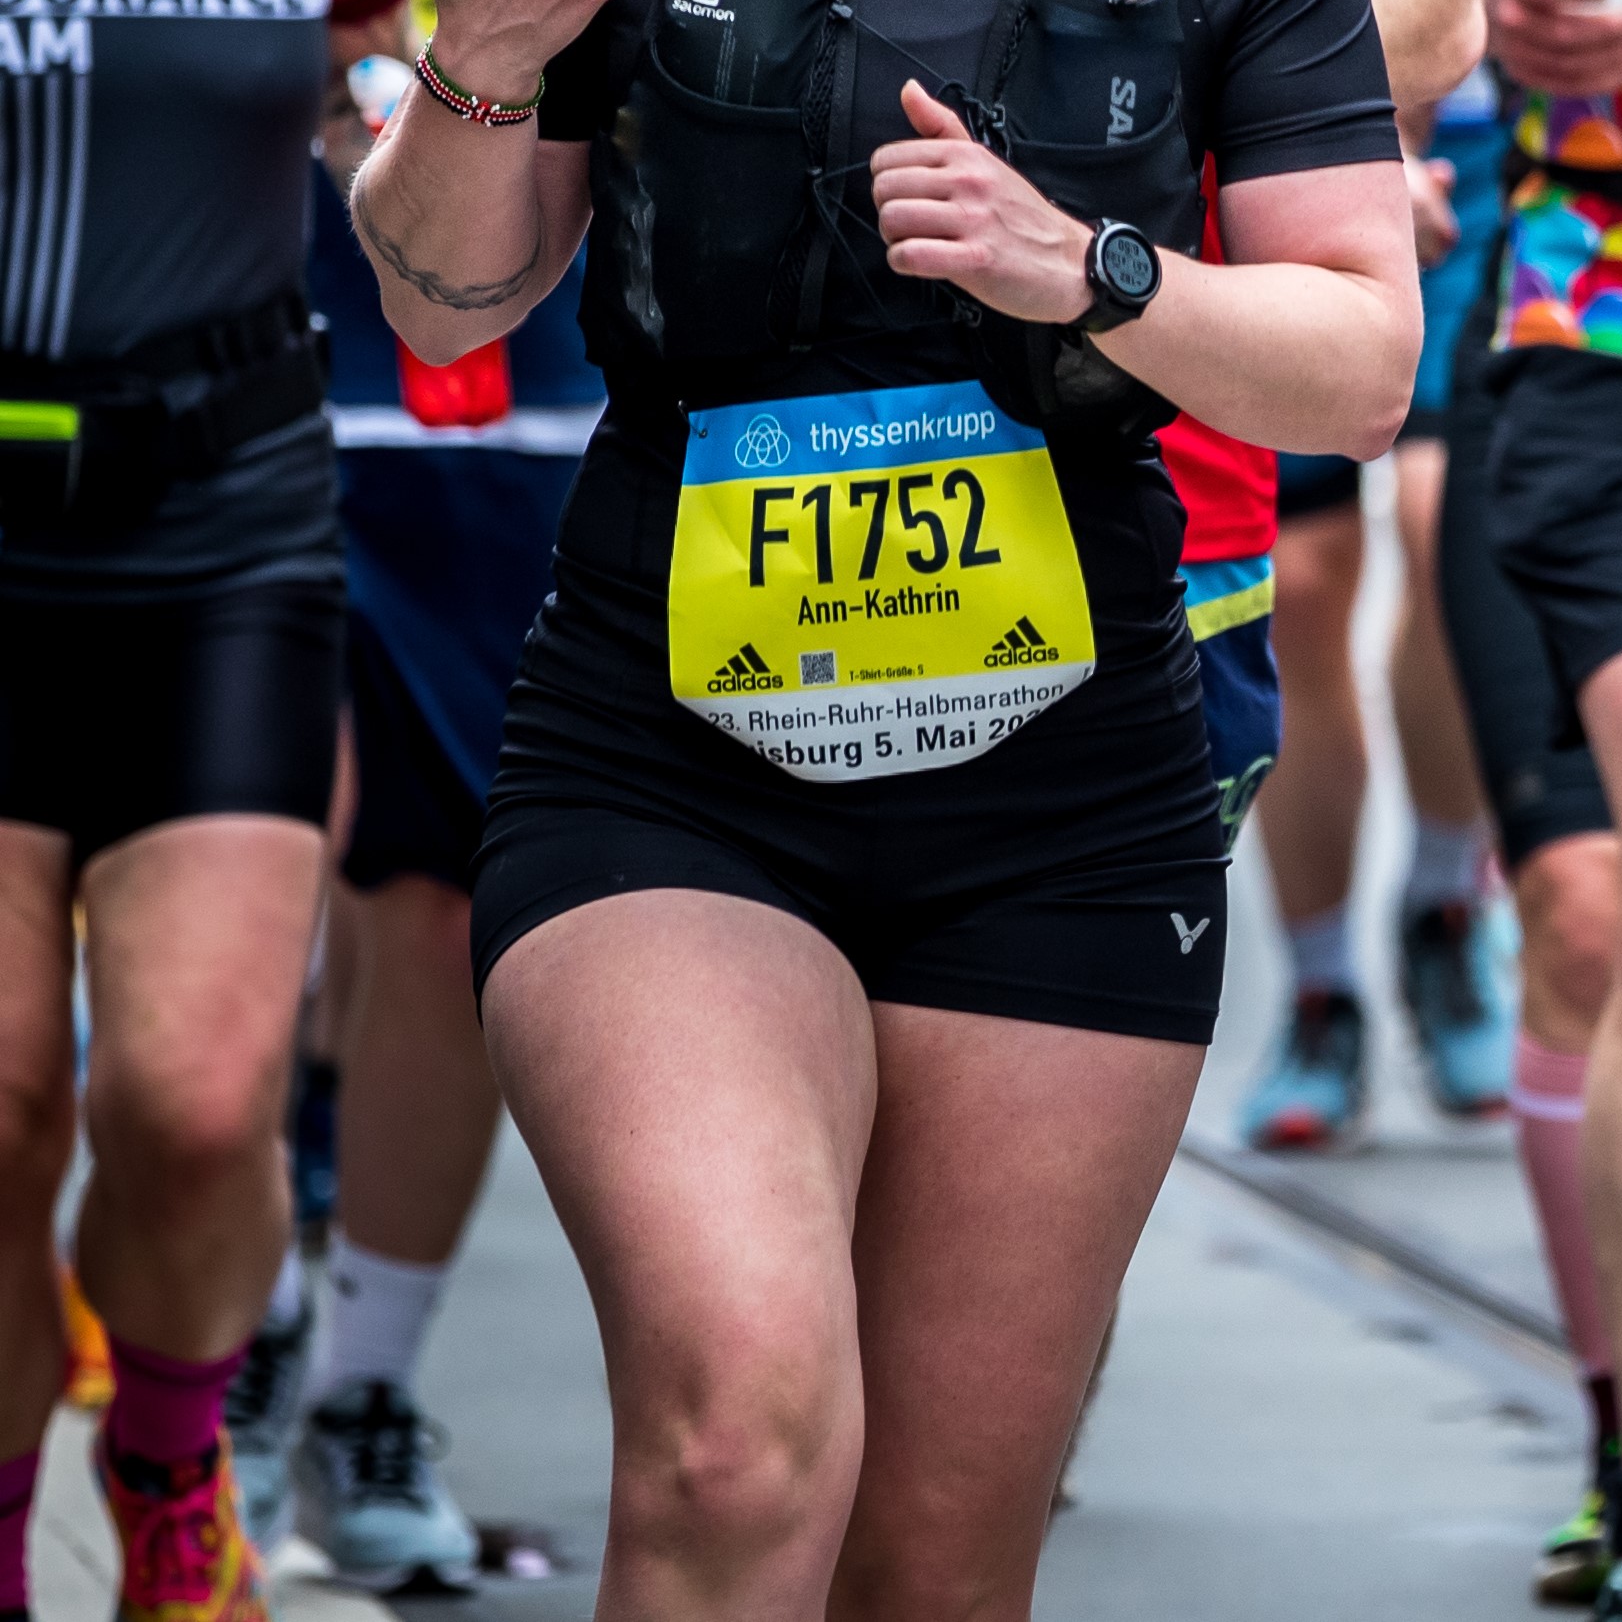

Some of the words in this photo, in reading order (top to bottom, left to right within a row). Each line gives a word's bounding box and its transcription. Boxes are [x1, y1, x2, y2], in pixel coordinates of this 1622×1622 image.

[809, 409, 997, 457] thyssenkrupp
[748, 468, 1002, 588] F1752
[797, 583, 961, 626] Ann-Kathrin
[984, 645, 1060, 669] adidas
[706, 673, 784, 694] adidas
[748, 683, 1064, 733] Rhein-Ruhr-Halbmarathon
[874, 731, 904, 759] 5.
[916, 719, 976, 755] Mai
